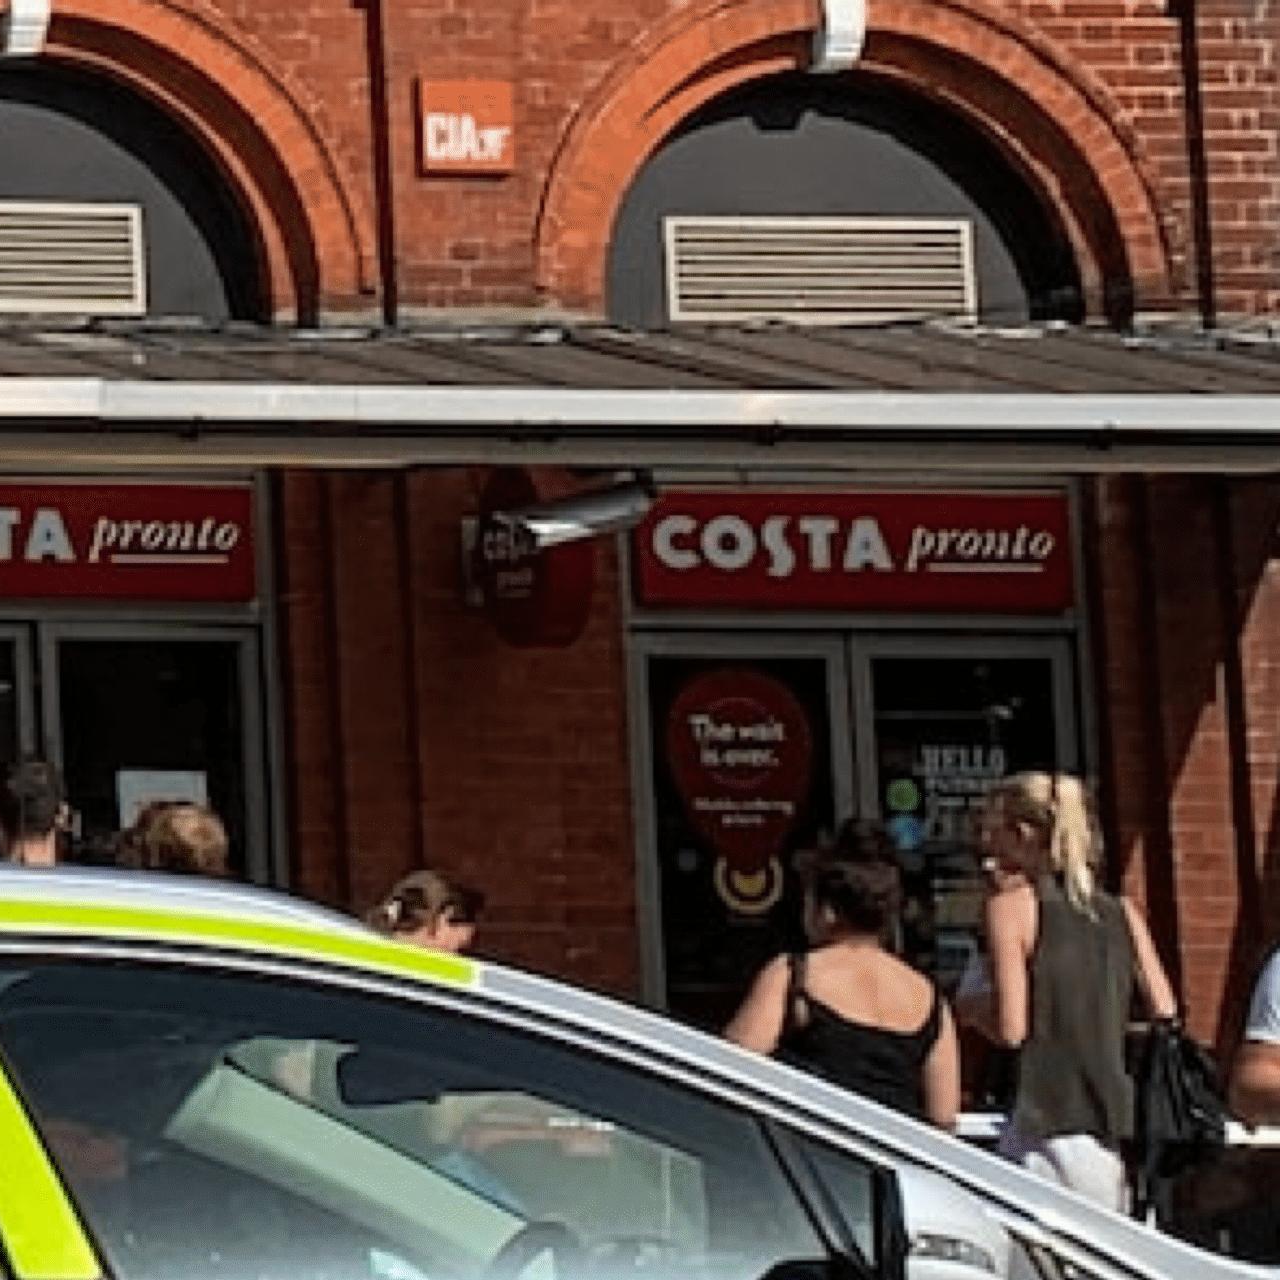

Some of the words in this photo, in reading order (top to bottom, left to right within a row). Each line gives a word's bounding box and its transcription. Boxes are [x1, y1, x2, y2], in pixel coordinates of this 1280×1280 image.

[88, 516, 241, 565] pronto
[652, 514, 896, 579] COSTA
[905, 526, 1057, 574] pronto
